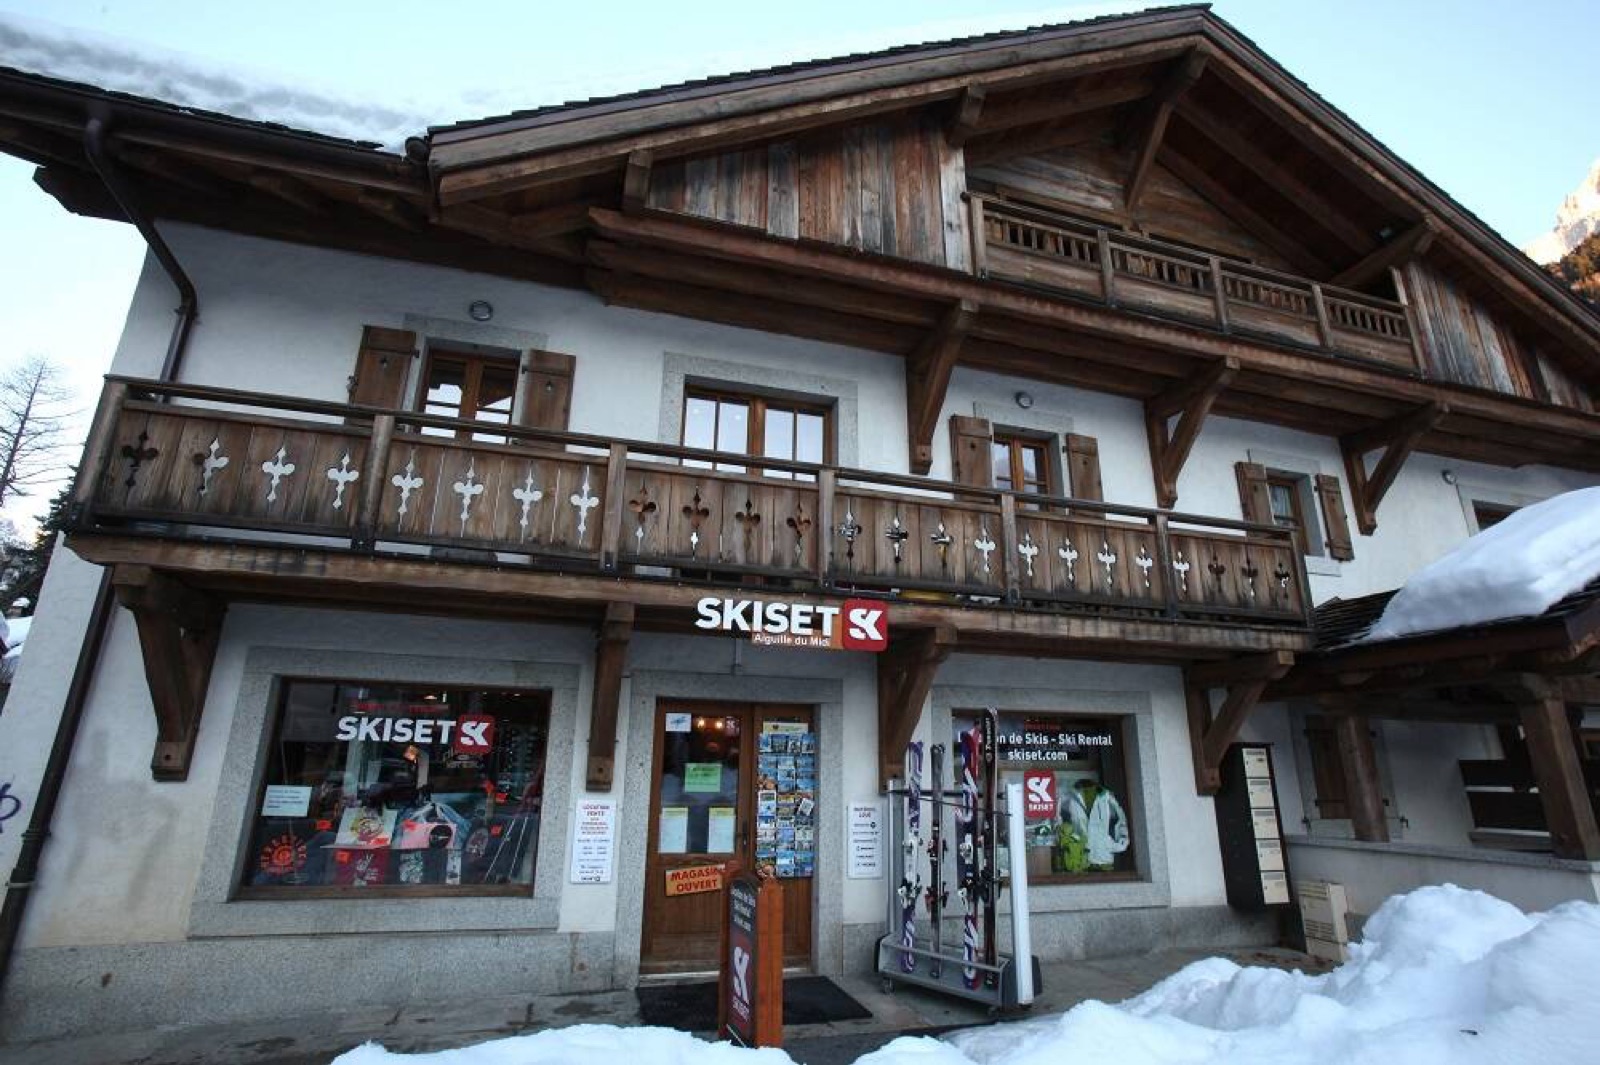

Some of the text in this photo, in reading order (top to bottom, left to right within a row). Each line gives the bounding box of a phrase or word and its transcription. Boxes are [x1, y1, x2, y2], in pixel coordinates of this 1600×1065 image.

[695, 597, 839, 636] SKISET
[753, 633, 791, 646] Aiguille
[794, 637, 807, 646] du
[335, 715, 457, 745] SKISET
[1009, 732, 1023, 745] de
[1025, 731, 1049, 745] Skis
[1059, 732, 1076, 746] Ski
[1078, 733, 1113, 746] Rental
[1007, 748, 1069, 762] skiset.com
[676, 879, 718, 893] OUVERT
